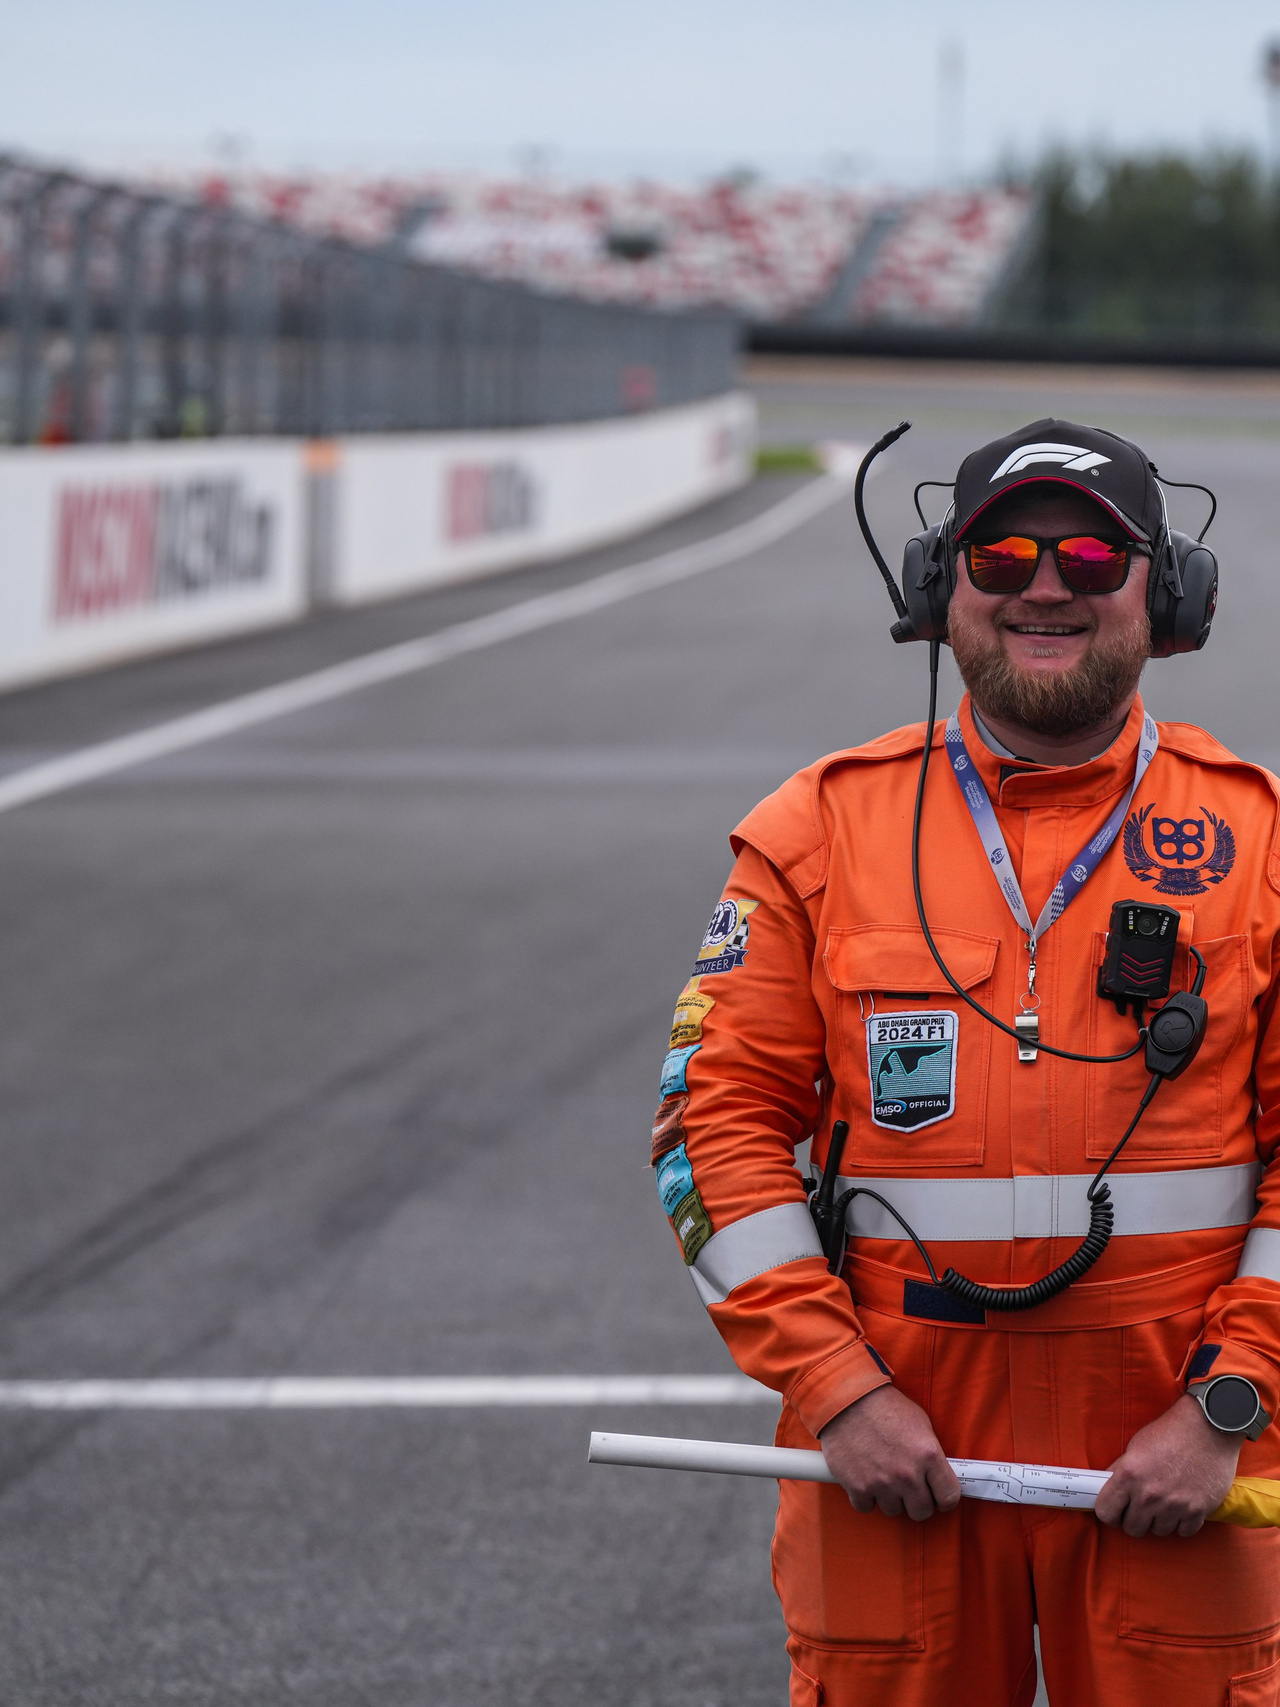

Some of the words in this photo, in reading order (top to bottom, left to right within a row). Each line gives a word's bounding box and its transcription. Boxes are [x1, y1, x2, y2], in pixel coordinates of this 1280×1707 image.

[878, 1021, 890, 1029] ABU
[891, 1019, 910, 1027] DHABI
[910, 1018, 930, 1026] GRAND
[931, 1017, 945, 1025] PRIX
[878, 1026, 923, 1042] 2024
[927, 1026, 945, 1039] F1
[876, 1104, 902, 1116] EMSO
[909, 1100, 947, 1109] OFFICIAL
